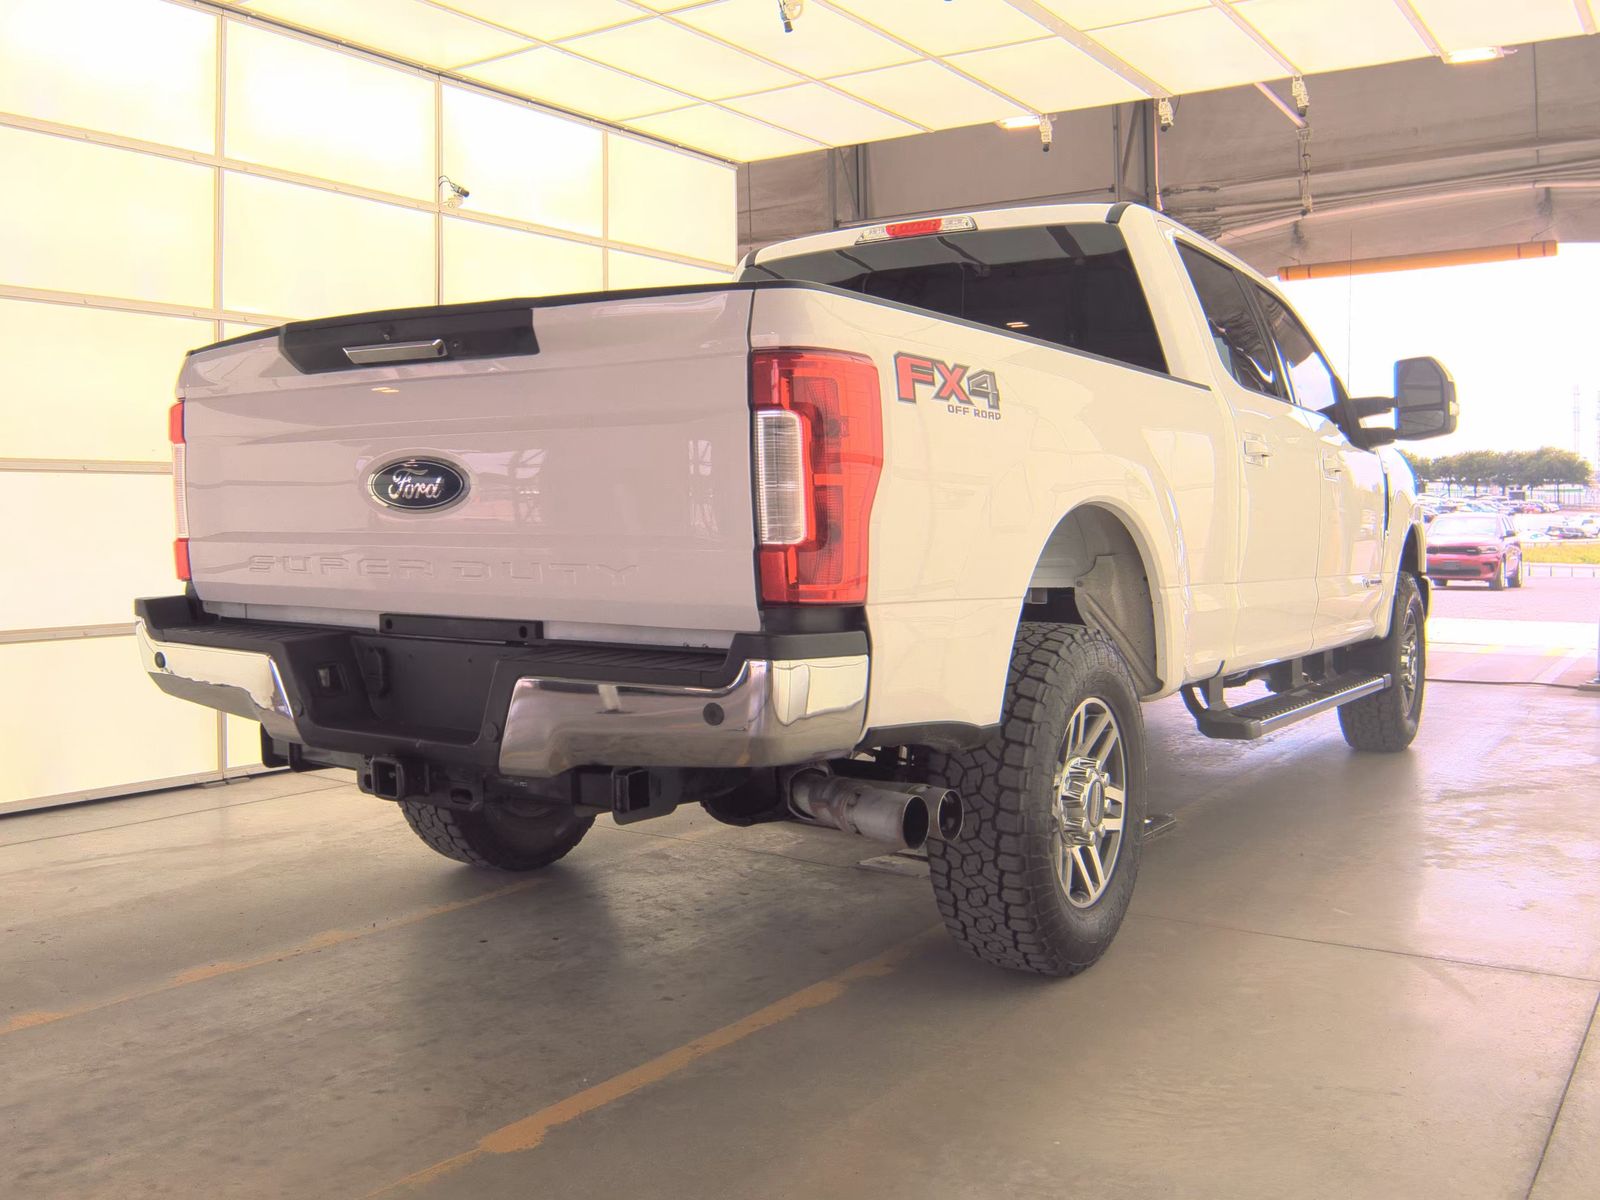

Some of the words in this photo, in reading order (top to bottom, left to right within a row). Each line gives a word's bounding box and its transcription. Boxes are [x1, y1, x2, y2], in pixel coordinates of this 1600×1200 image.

[893, 351, 1000, 410] FX4
[947, 404, 970, 416] OFF
[973, 408, 1001, 421] ROAD
[388, 468, 443, 499] Ford
[248, 554, 435, 577] SUPER
[451, 559, 641, 585] DUTY
